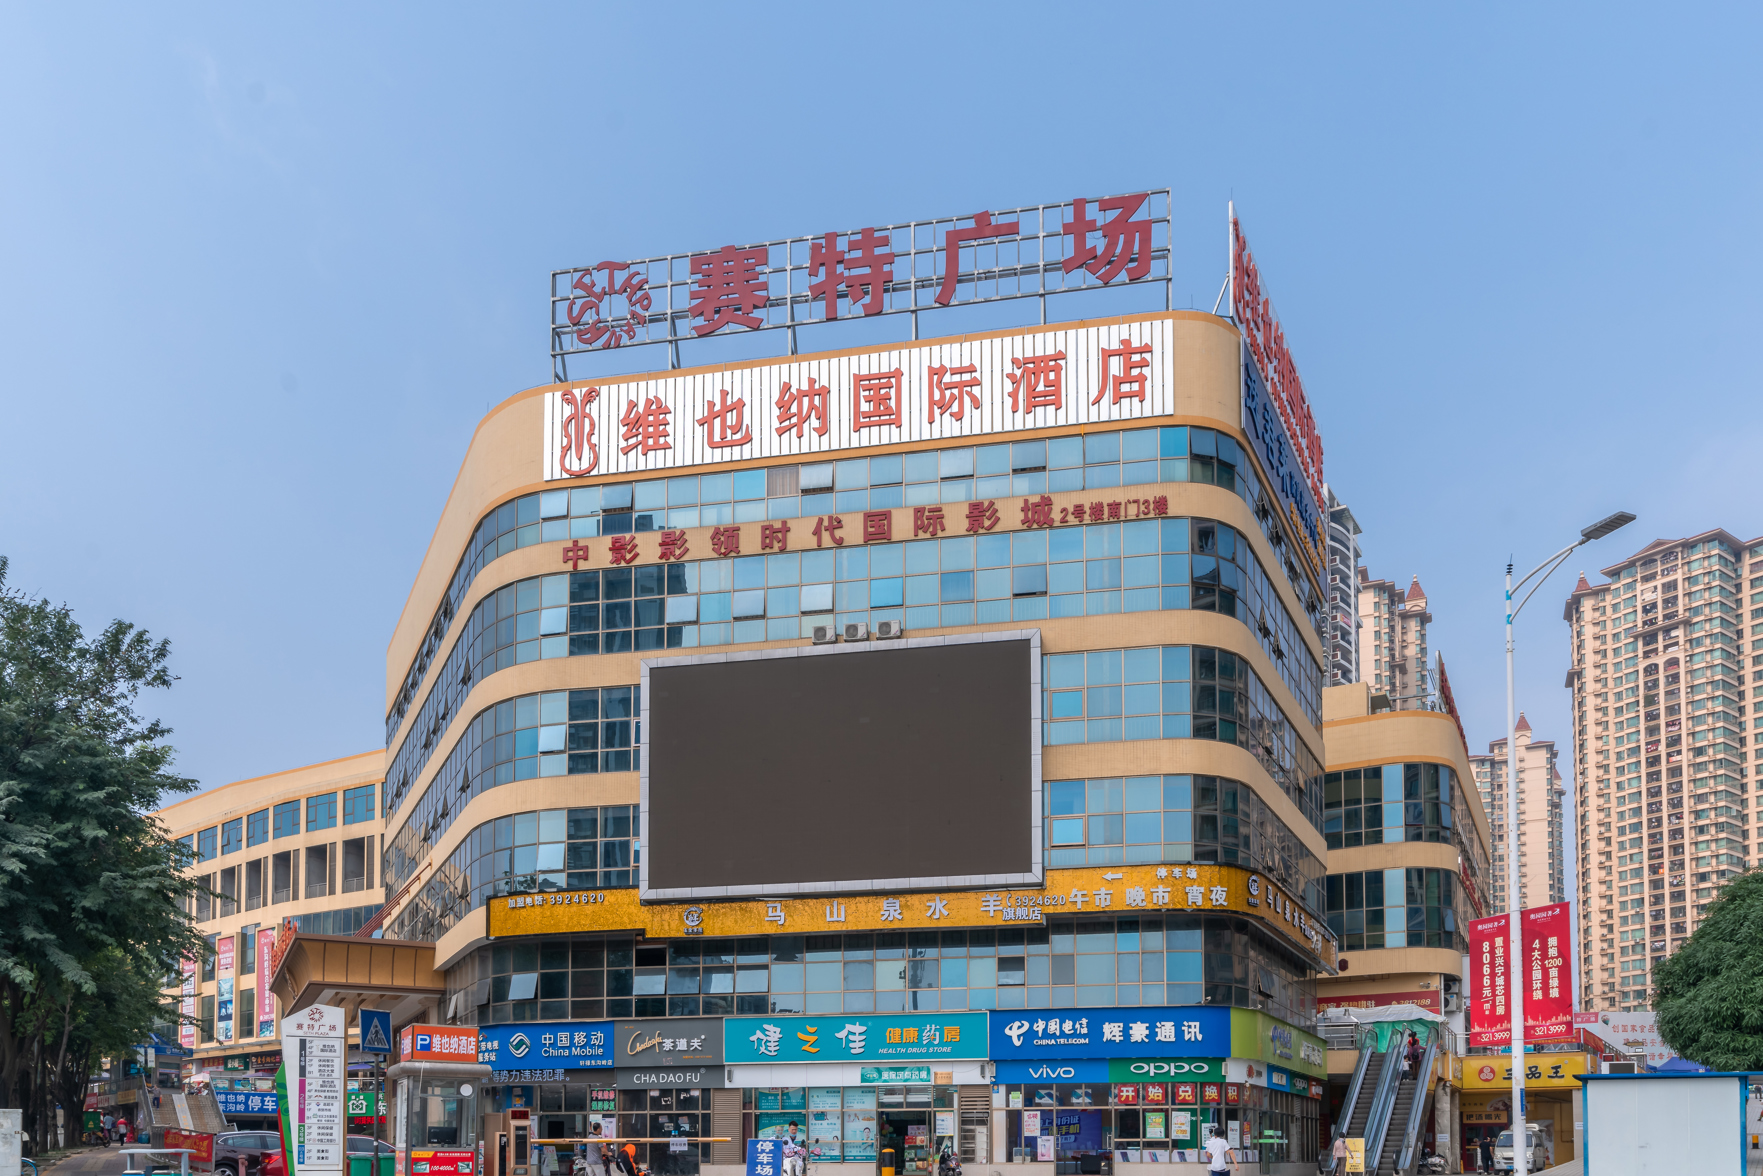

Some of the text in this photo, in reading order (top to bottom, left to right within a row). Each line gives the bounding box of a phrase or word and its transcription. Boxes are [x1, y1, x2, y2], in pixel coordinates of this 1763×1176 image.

[688, 192, 1153, 337] 赛特广场
[618, 338, 1154, 457] 维也纳国际酒店
[562, 494, 1169, 570] 中影影领时代国际影城 2号楼南门3楼
[1156, 867, 1198, 880] 停车场
[549, 892, 605, 905] 3924620
[1069, 887, 1114, 910] 午市
[1126, 885, 1171, 907] 晚市
[1185, 885, 1228, 907] 宵夜
[765, 893, 1066, 926] 马山泉水羊 3924620
[1002, 907, 1042, 921] 旗舰店
[1495, 936, 1505, 1015] 置业兴宁城芯四房
[1531, 939, 1543, 1001] 4大公园环绕
[1544, 936, 1563, 998] 拥抱1200亩绿境
[296, 1023, 337, 1032] 赛特广场
[885, 1024, 961, 1045] 健康药房
[1033, 1018, 1089, 1037] 中国电信
[1103, 1021, 1203, 1043] 辉豪通讯
[417, 1035, 430, 1050] P
[432, 1033, 476, 1055] 维也纳酒店
[478, 1040, 499, 1051] 带电视
[541, 1030, 604, 1047] 中国移动
[662, 1038, 702, 1051] 茶道夫
[749, 1022, 867, 1057] 健之佳
[541, 1046, 604, 1057] China Mobile
[633, 1072, 700, 1084] CHA DAO FU
[881, 1071, 928, 1080] 医保定点药房
[1028, 1064, 1075, 1079] vivo
[217, 1094, 245, 1102] 维也纳
[248, 1096, 277, 1111] 停车
[1466, 1113, 1501, 1121] 把汤喝光
[755, 1141, 775, 1176] 停车场
